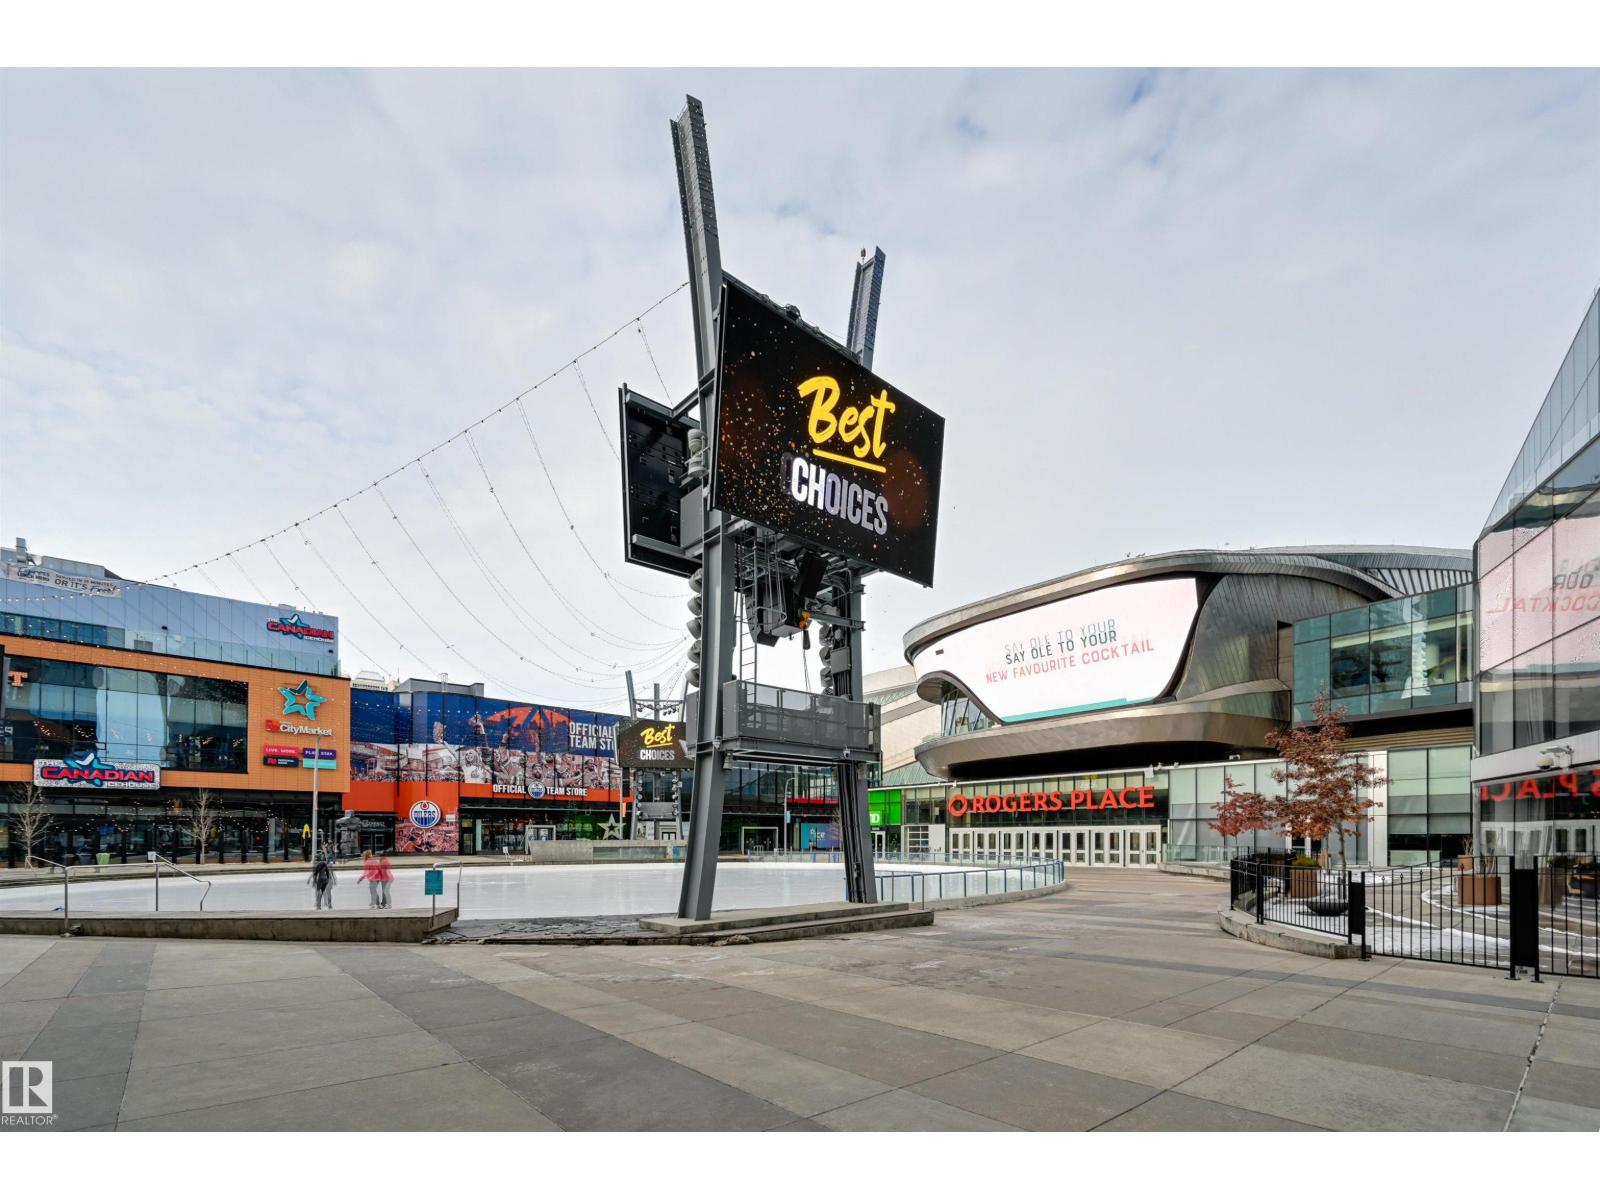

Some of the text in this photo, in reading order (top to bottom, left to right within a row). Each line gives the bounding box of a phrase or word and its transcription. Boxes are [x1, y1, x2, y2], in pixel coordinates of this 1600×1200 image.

[797, 376, 896, 458] Best
[791, 457, 889, 535] CHOICES
[54, 578, 68, 586] OR
[71, 582, 88, 590] IT'S
[267, 622, 335, 639] CANADIAN
[1006, 650, 1026, 665] SAY
[1058, 640, 1075, 653] TO
[1081, 630, 1117, 648] YOUR
[986, 639, 1155, 684] NEW FAVOURITE COCKTAIL
[280, 724, 332, 736] CityMarket
[569, 722, 613, 738] OFFICIAL
[640, 724, 675, 745] Best
[570, 736, 614, 750] TEAM ST
[639, 749, 675, 761] CHOICES
[42, 767, 153, 782] CANADIAN
[493, 784, 588, 797] OFFICIAL TEAM STORE
[972, 785, 1155, 813] ROGERS PLACE
[413, 810, 436, 826] OILERS
